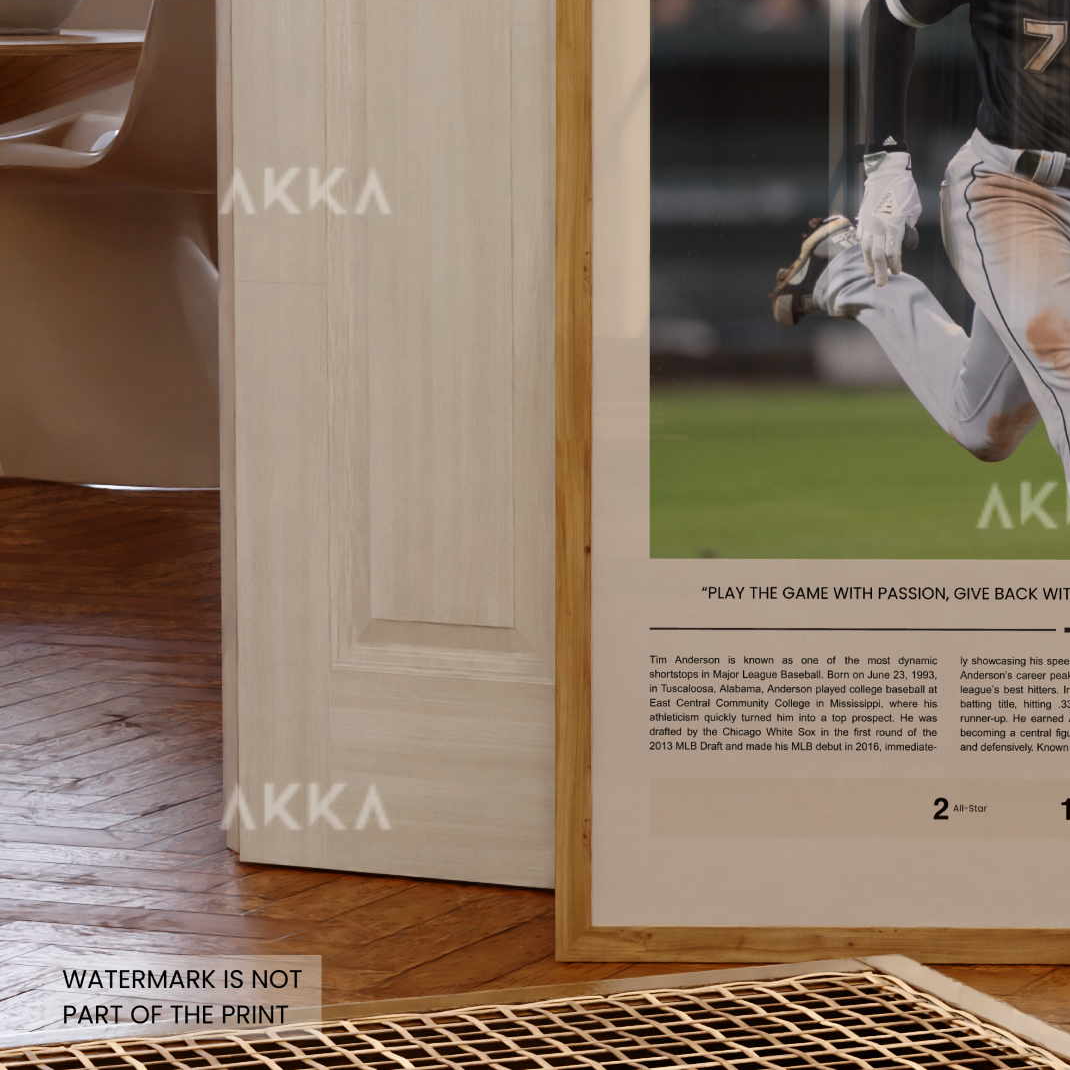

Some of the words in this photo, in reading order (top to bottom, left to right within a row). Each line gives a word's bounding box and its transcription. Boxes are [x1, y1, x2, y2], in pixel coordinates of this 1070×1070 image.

[1023, 17, 1068, 74] 7
[700, 585, 746, 600] “PLAY
[748, 586, 778, 600] THE
[781, 585, 829, 600] GAME
[832, 586, 873, 600] WITH
[877, 586, 950, 603] PASSION,
[953, 586, 990, 601] GIVE
[994, 586, 1039, 601] BACK
[648, 654, 668, 665] Tim
[674, 654, 721, 665] Anderson
[727, 655, 736, 665] is
[743, 655, 775, 665] known
[781, 657, 794, 665] as
[800, 657, 819, 665] one
[826, 655, 837, 665] of
[844, 655, 860, 665] the
[867, 656, 891, 665] most
[897, 655, 939, 668] dynamic
[960, 655, 969, 668] ly
[971, 656, 1027, 668] showcasing
[1029, 656, 1044, 666] his
[649, 669, 699, 681] shortstops
[701, 669, 711, 679] in
[712, 669, 740, 681] Major
[742, 669, 778, 682] League
[780, 669, 824, 680] Baseball.
[826, 669, 850, 680] Born
[852, 671, 865, 680] on
[866, 669, 891, 680] June
[892, 669, 908, 681] 23,
[911, 669, 938, 681] 1993,
[959, 670, 1013, 680] Anderson’s
[1015, 672, 1047, 681] career
[933, 797, 949, 820] 2
[952, 803, 988, 813] All-Star
[1061, 798, 1070, 820] 1
